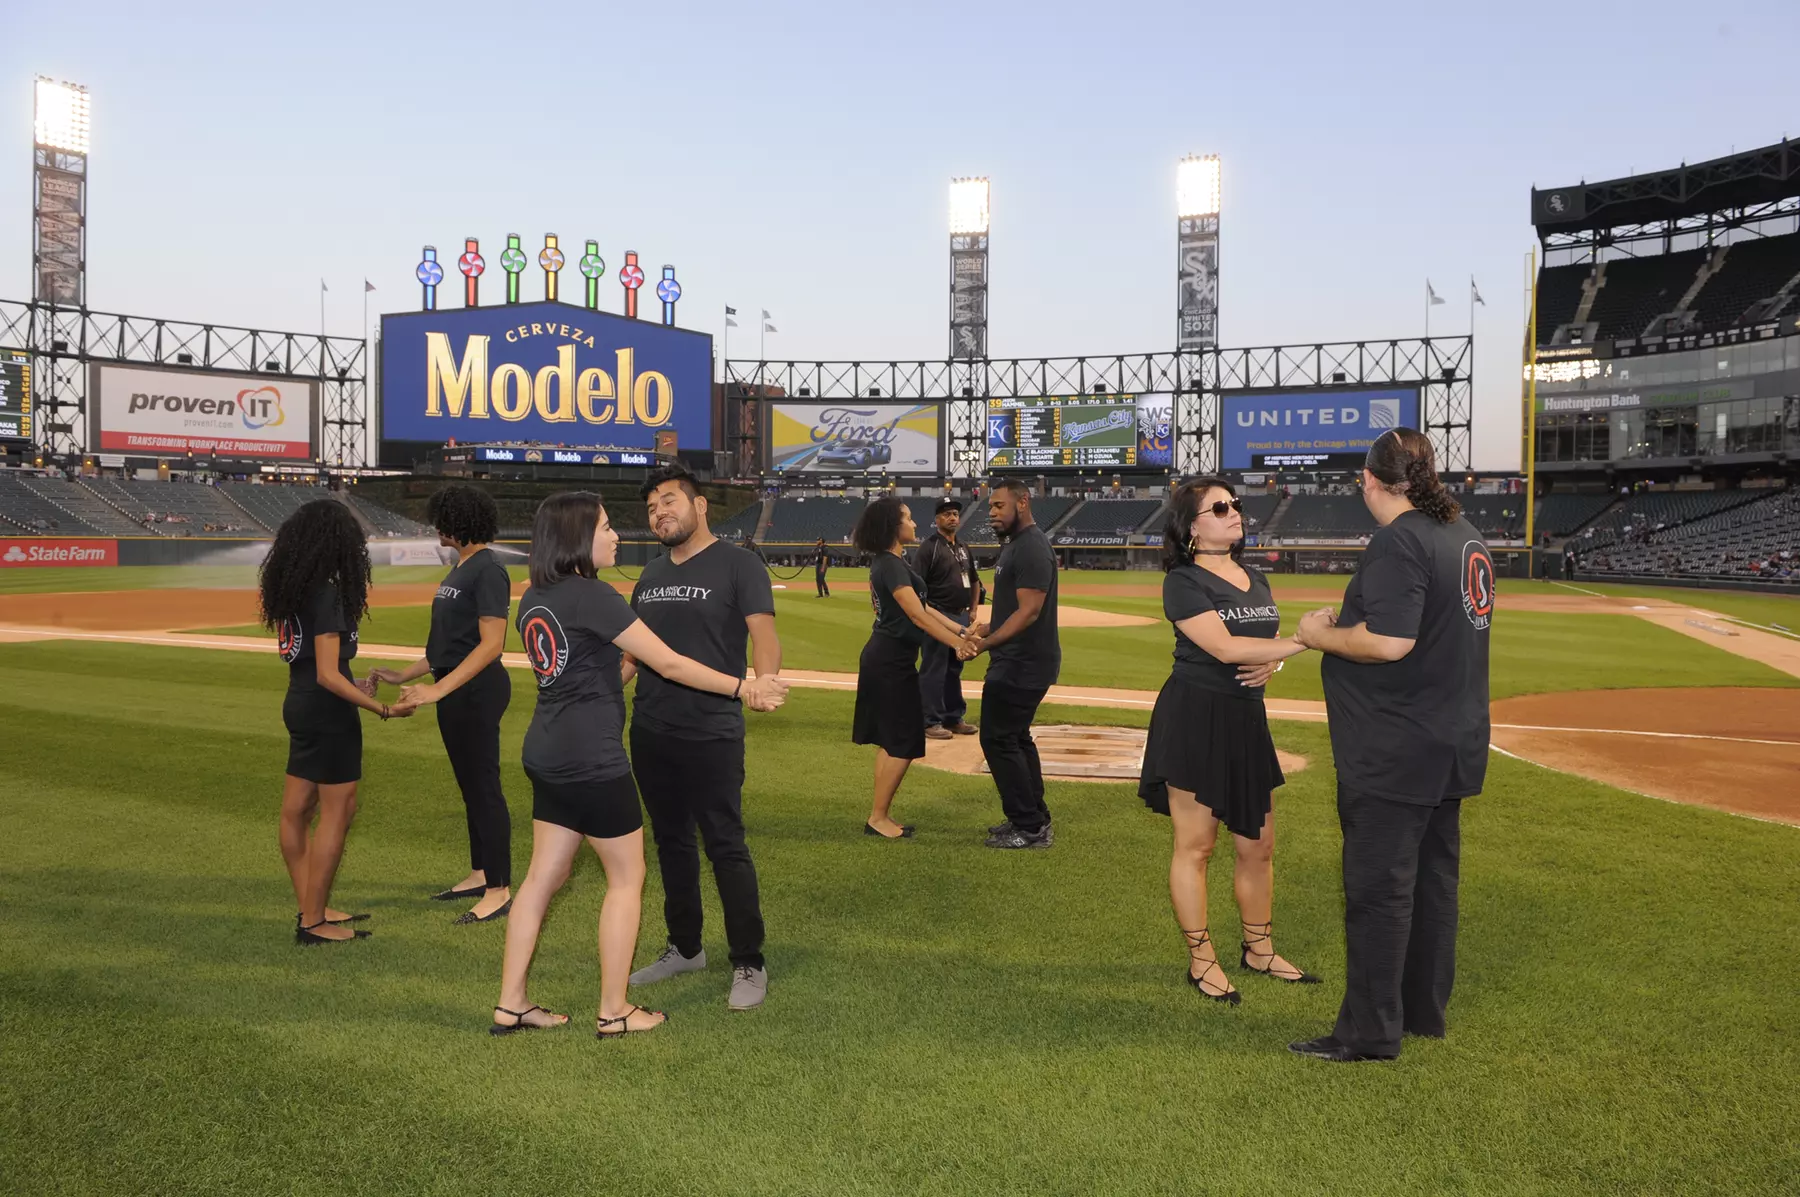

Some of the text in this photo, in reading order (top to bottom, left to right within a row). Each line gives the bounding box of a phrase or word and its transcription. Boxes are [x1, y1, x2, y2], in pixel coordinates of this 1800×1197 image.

[505, 322, 596, 348] CERVEZA
[1184, 321, 1212, 332] SOX
[425, 332, 673, 426] Modelo
[128, 392, 272, 418] proven IT
[990, 399, 1002, 408] 39
[1544, 394, 1640, 412] Huntington Bank
[810, 408, 899, 444] Ford
[1062, 418, 1108, 440] Kansas
[1108, 409, 1134, 429] City
[1237, 408, 1360, 427] UNITED
[128, 436, 286, 453] TRANSFORMING WORKPLACE PRODUCTIVITY
[1284, 441, 1295, 450] fly
[1313, 440, 1346, 449] Chicago
[486, 449, 647, 464] Modelo Modelo Modelo
[960, 451, 978, 460] 6:34
[677, 586, 712, 600] CITY
[1218, 607, 1258, 621] SALSA
